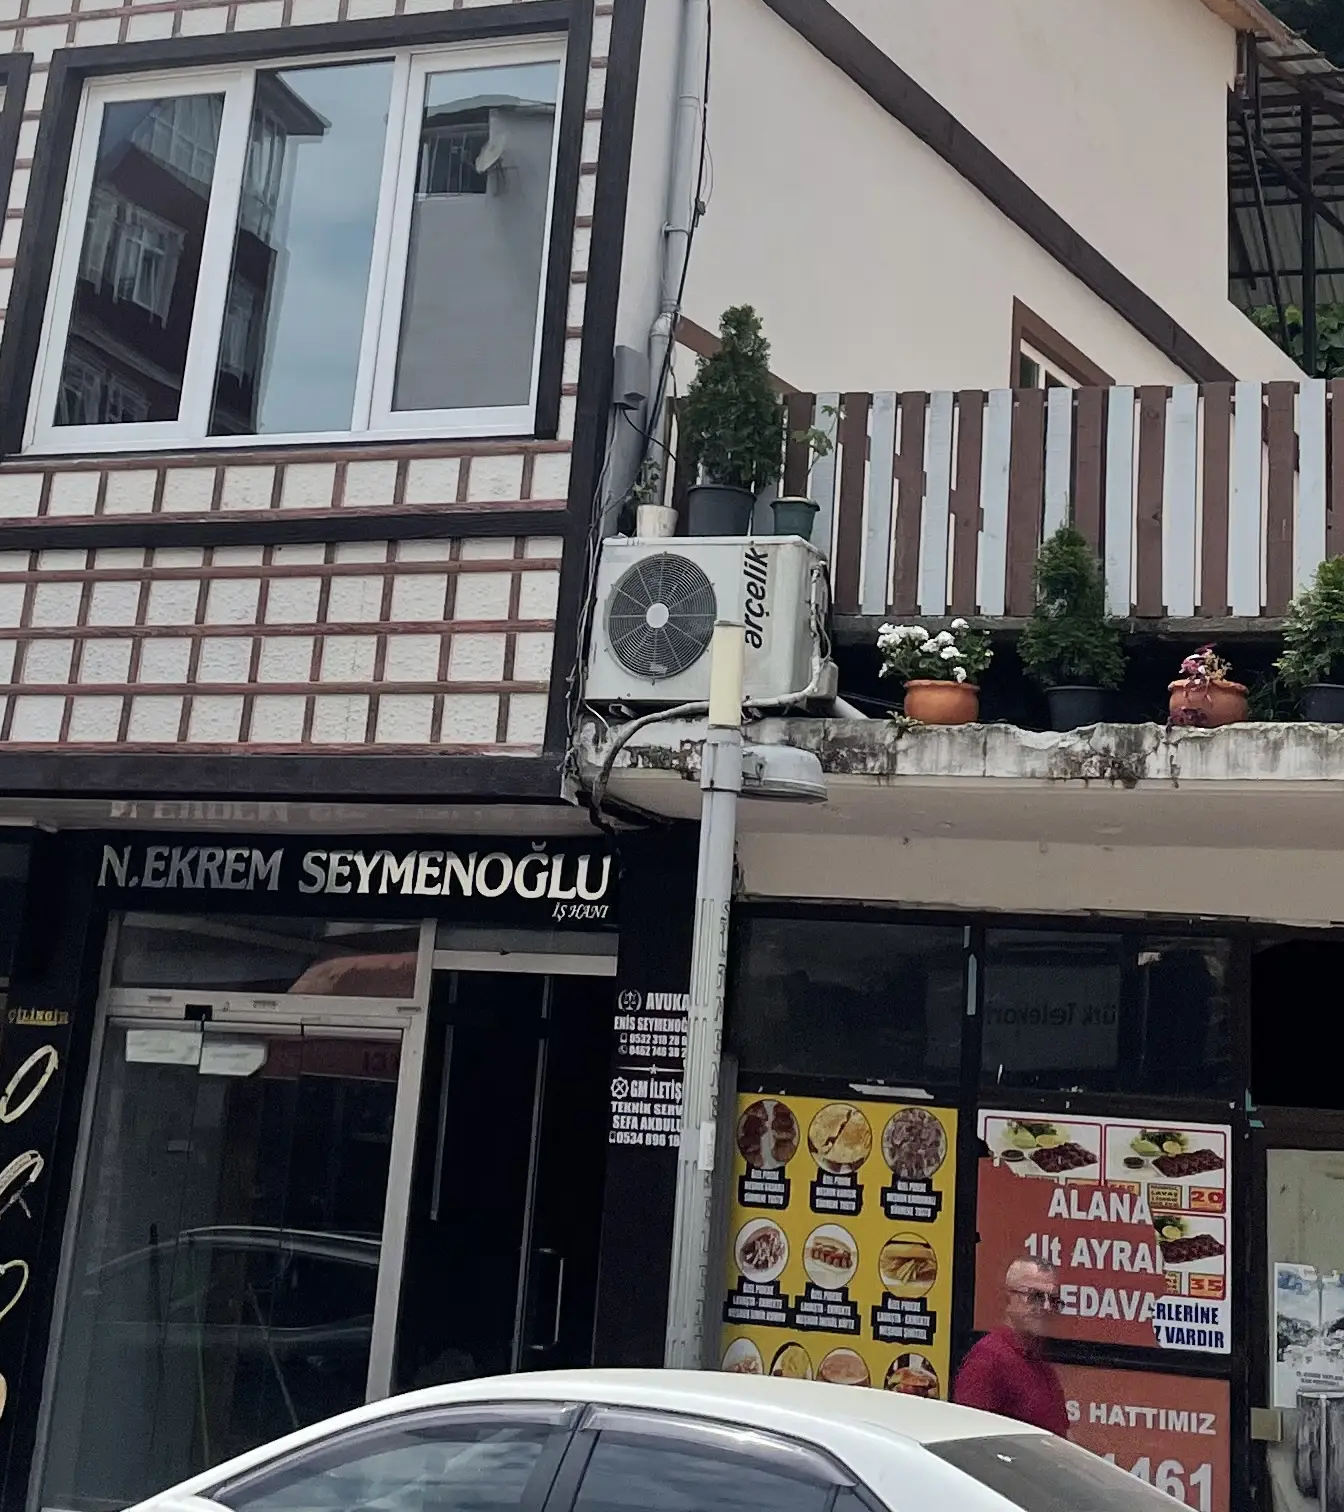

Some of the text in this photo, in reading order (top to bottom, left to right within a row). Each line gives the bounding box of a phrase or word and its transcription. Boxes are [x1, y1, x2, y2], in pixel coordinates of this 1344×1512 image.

[744, 547, 769, 649] arçelik
[97, 842, 612, 901] N.EKREM SEYMENOĞLU
[1047, 1188, 1153, 1226] ALANA
[1190, 1277, 1224, 1292] 35
[1165, 1326, 1225, 1349] VARDIR
[1089, 1402, 1217, 1435] HATTIMIZ
